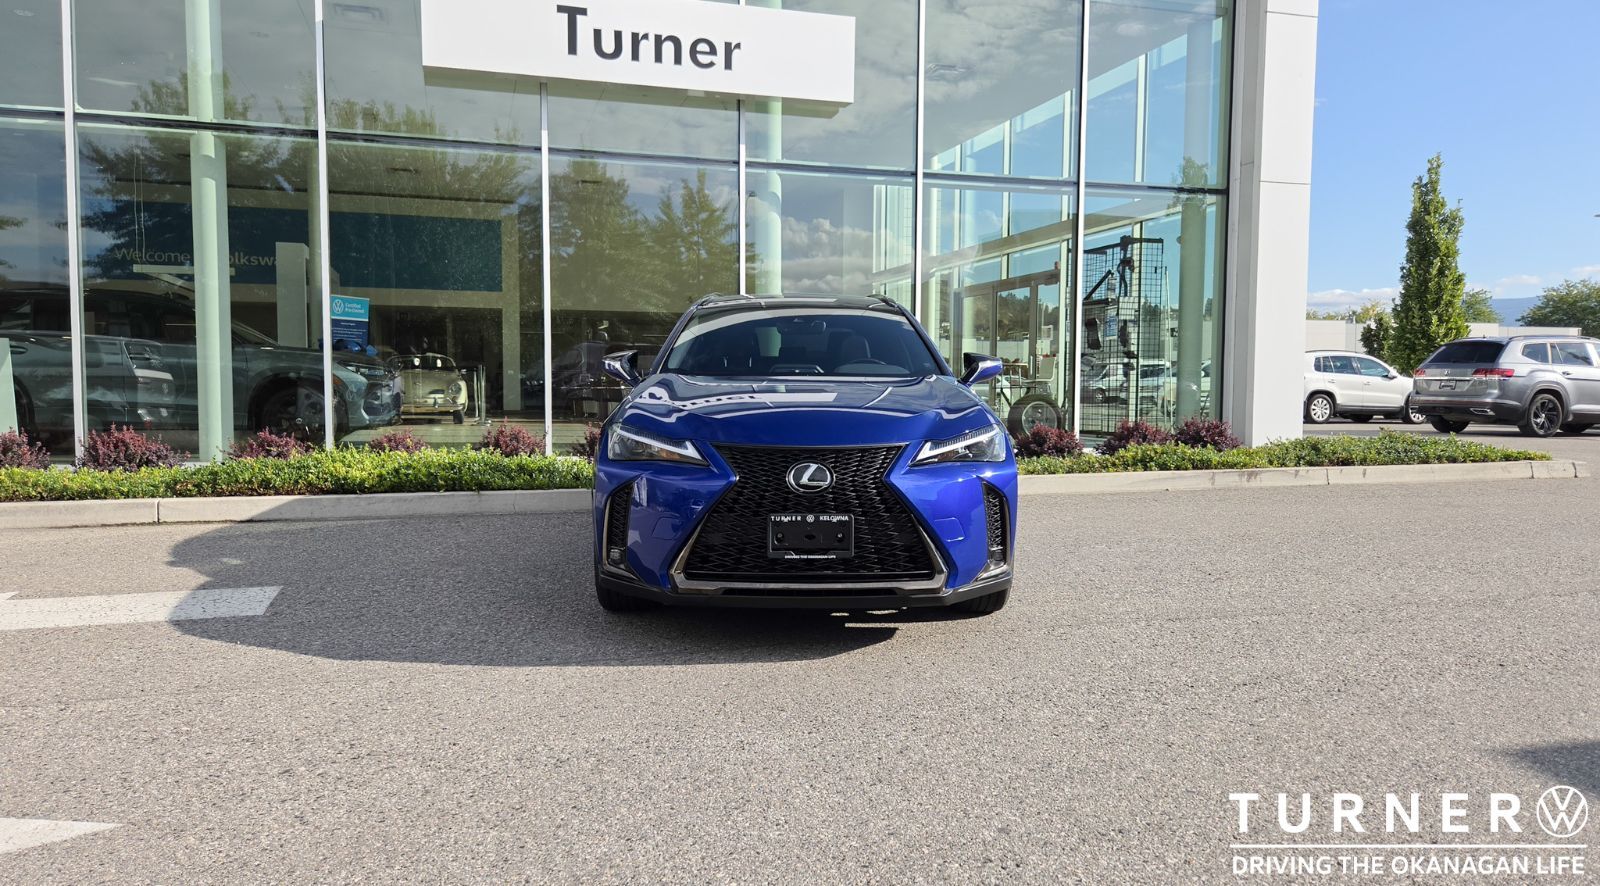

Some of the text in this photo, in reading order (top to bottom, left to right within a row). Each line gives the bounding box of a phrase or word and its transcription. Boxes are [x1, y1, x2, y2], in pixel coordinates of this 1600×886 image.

[556, 4, 742, 71] Turner
[114, 247, 277, 266] Welcome olksw
